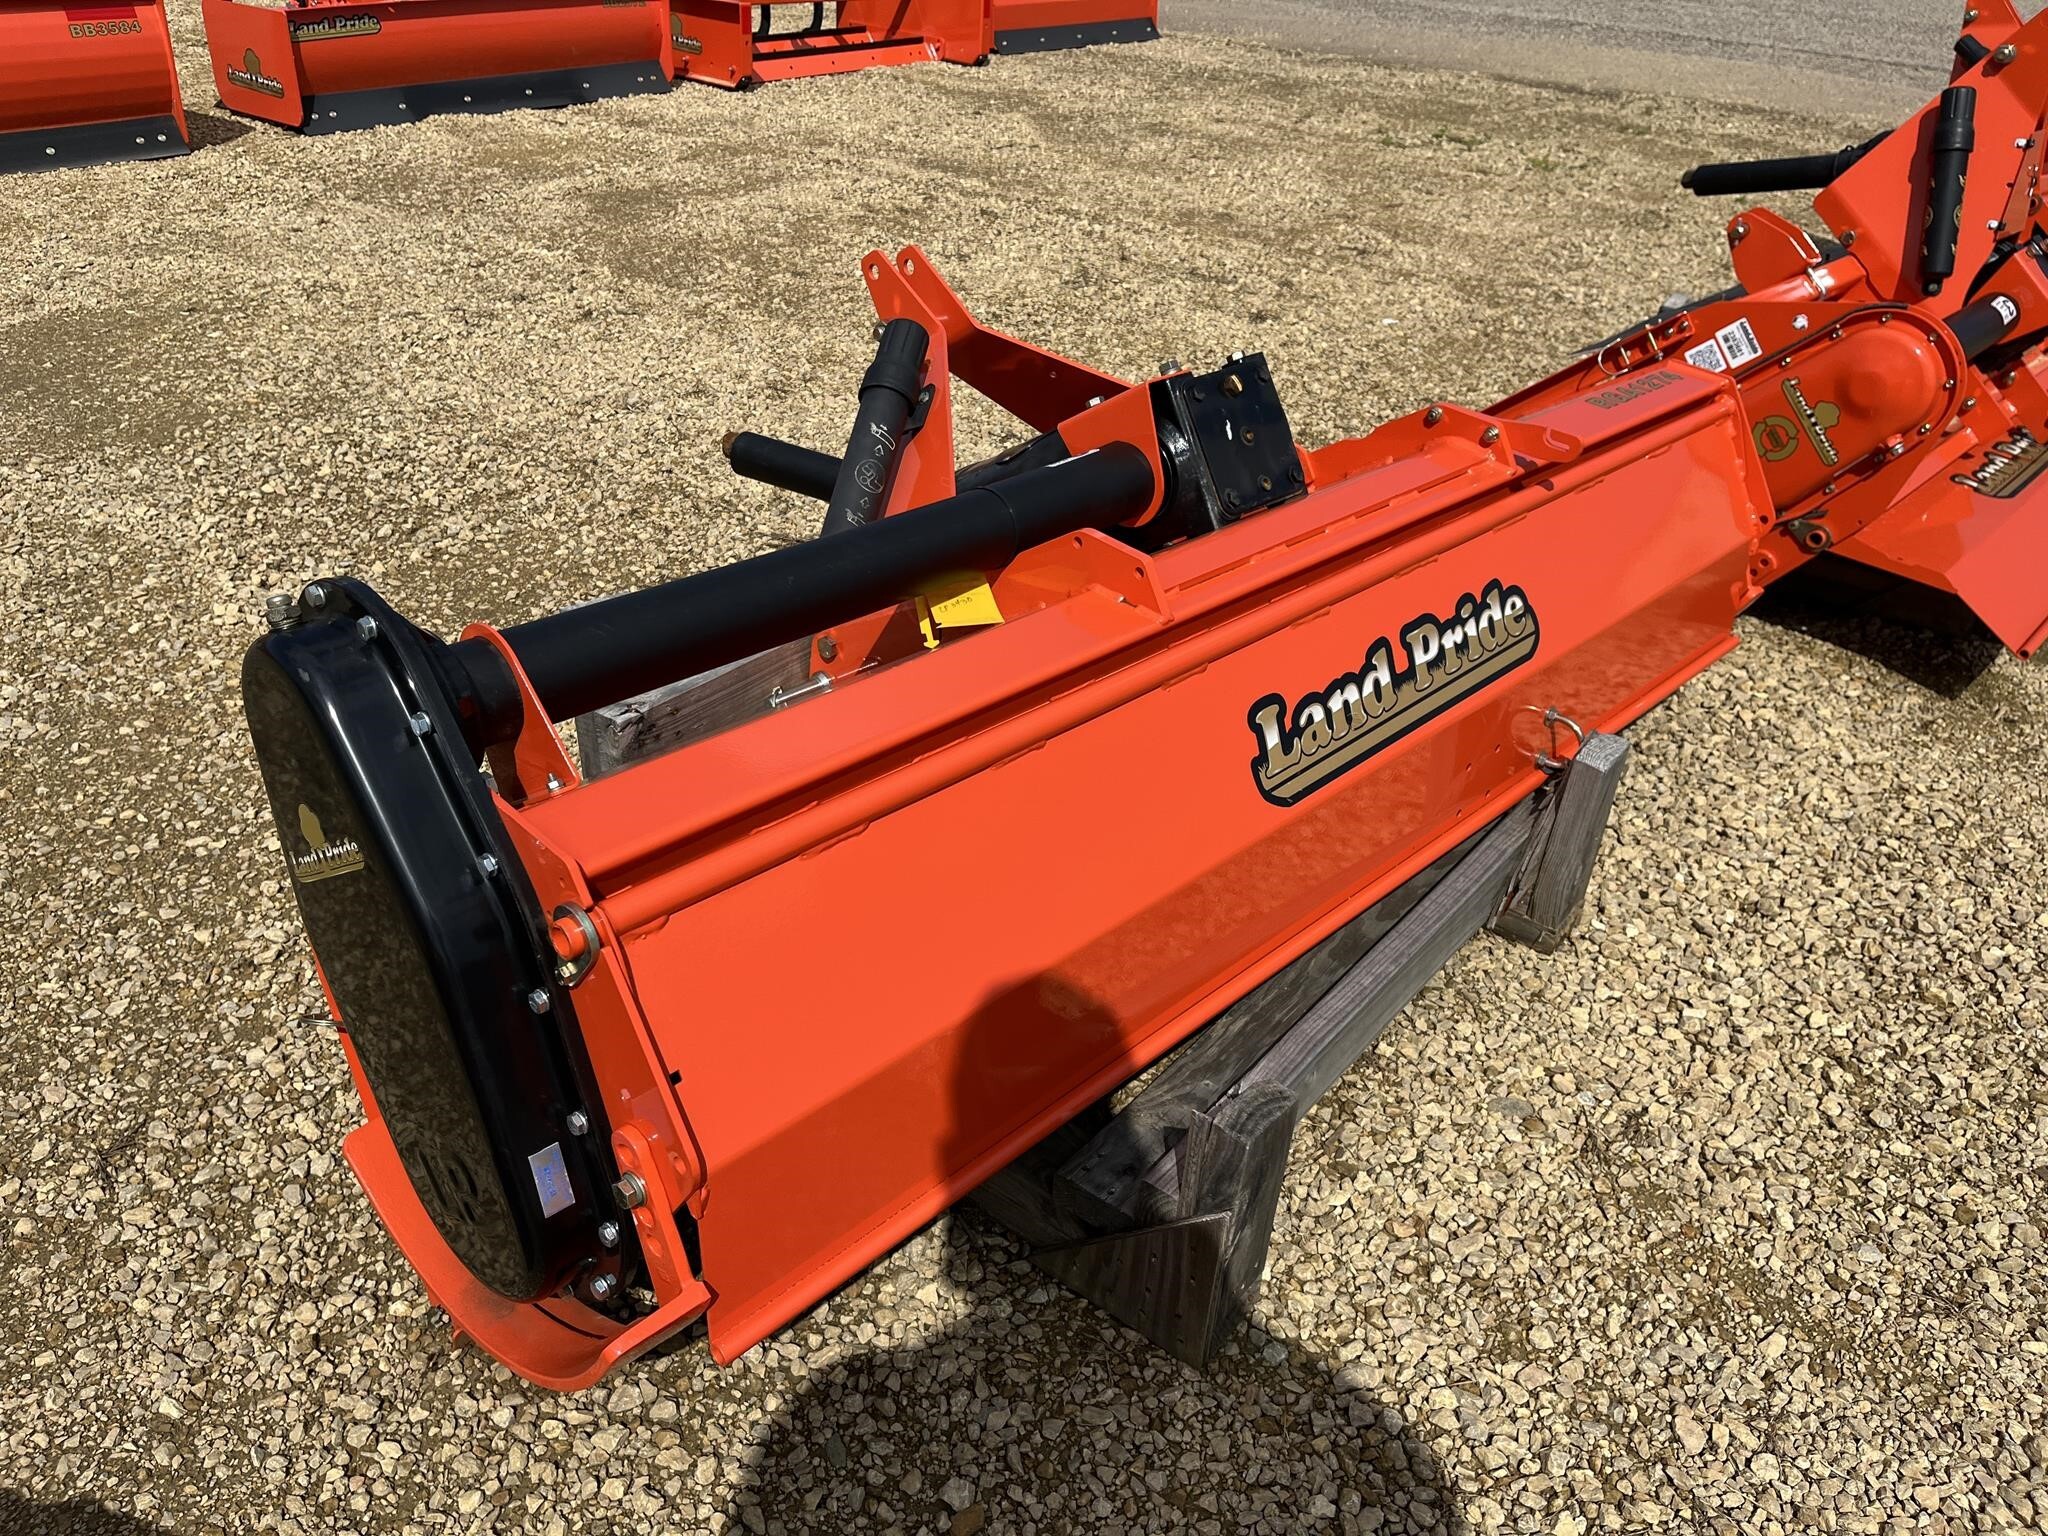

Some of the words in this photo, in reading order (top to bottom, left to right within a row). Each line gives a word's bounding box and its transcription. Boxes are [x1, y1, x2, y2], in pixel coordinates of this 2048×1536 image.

[69, 21, 142, 38] BB3584
[290, 18, 330, 36] Land
[334, 14, 379, 31] Pride
[228, 65, 250, 83] Land
[1954, 453, 2015, 492] Land
[1255, 647, 1398, 780] Land
[1405, 587, 1527, 693] Pride
[289, 848, 320, 873] Land
[323, 836, 360, 866] Pride
